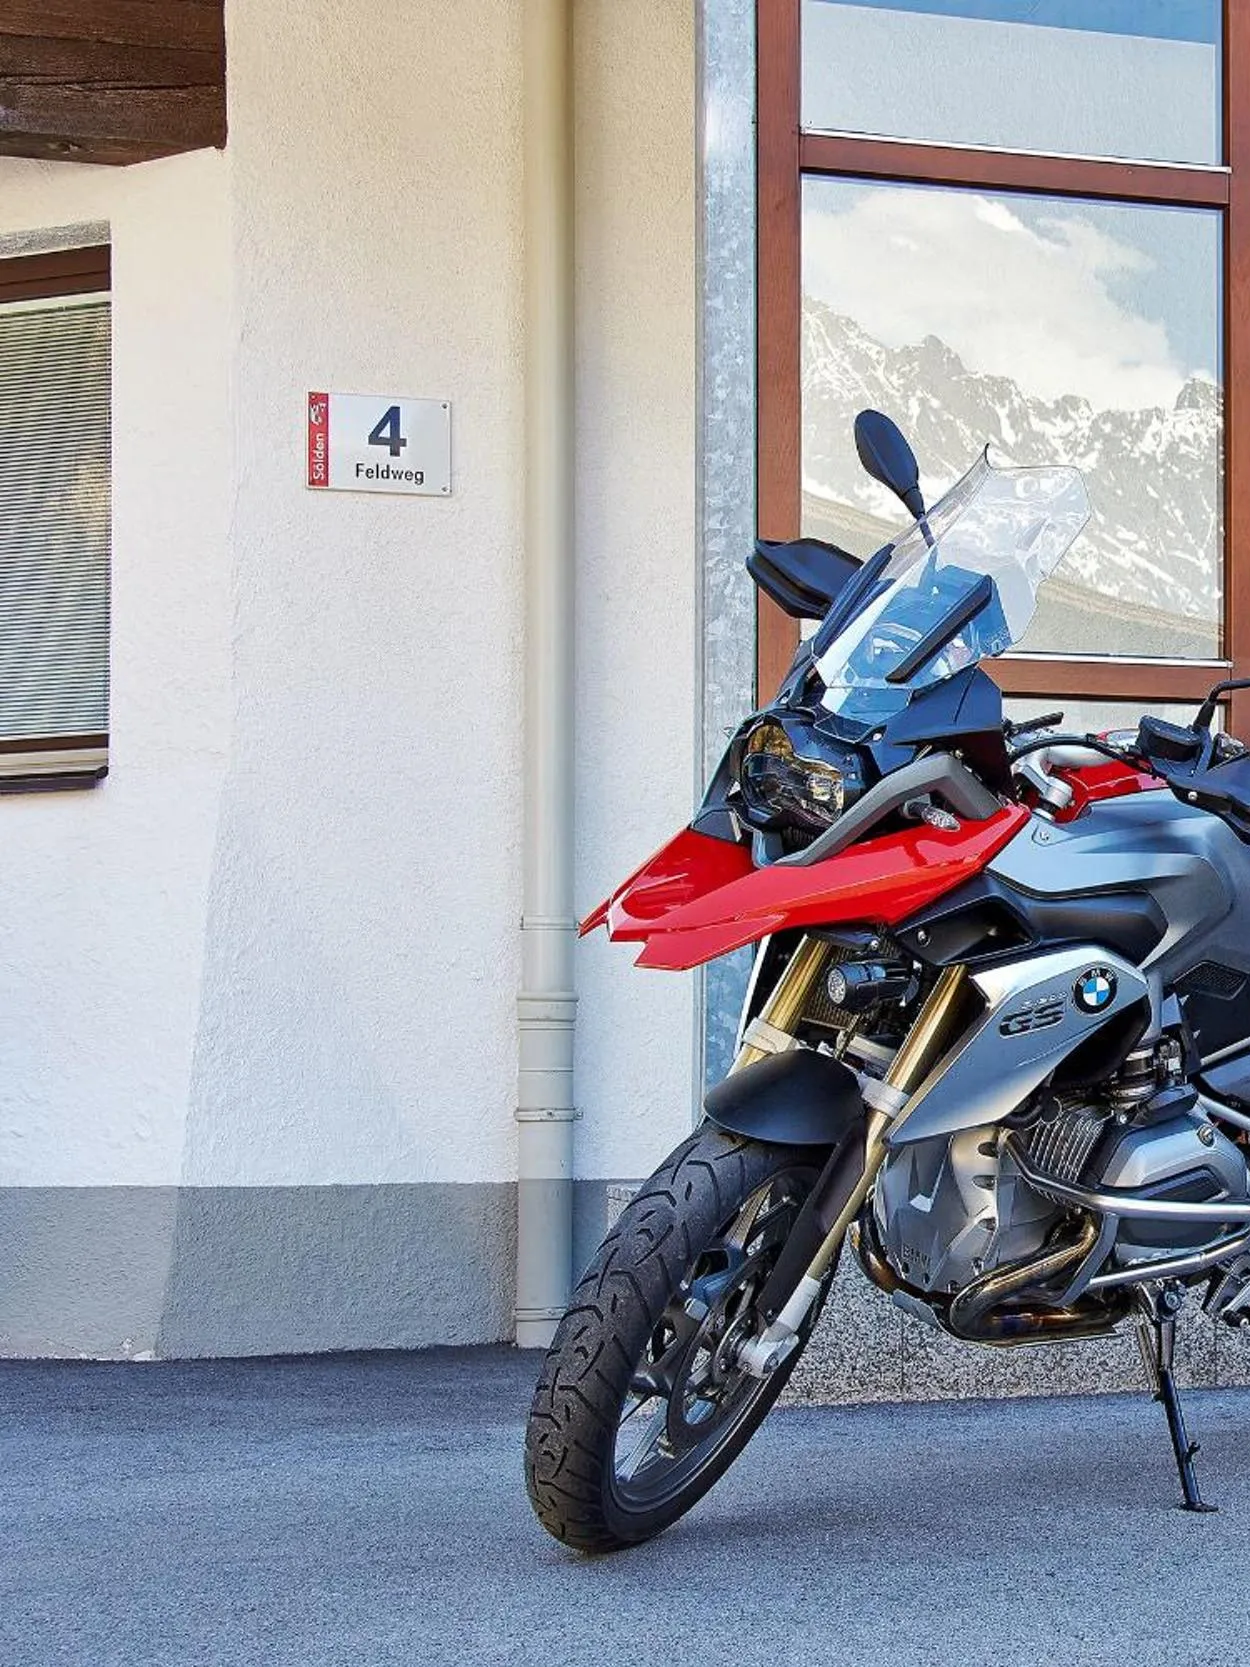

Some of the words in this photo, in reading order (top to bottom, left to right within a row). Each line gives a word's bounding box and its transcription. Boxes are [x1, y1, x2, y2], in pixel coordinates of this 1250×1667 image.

[368, 405, 407, 457] 4
[313, 432, 325, 480] Sölden
[356, 463, 424, 485] Feldweg
[1000, 1001, 1064, 1036] GS
